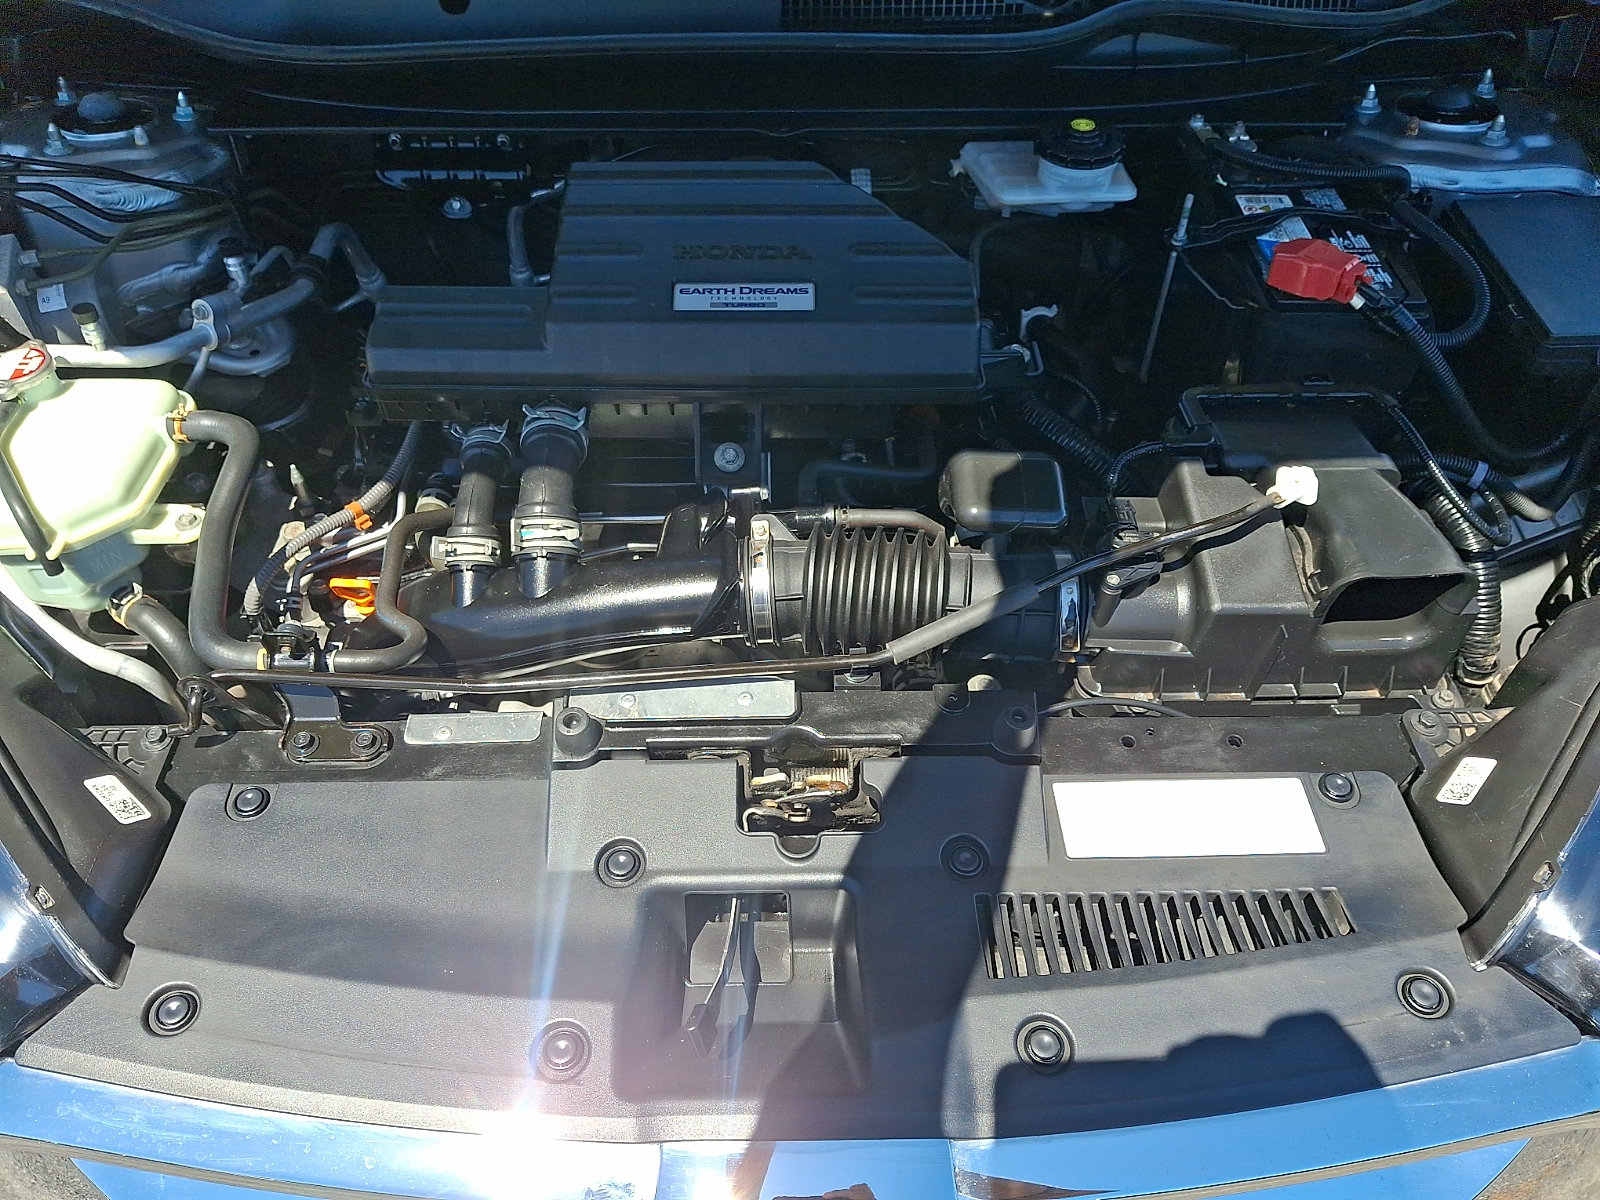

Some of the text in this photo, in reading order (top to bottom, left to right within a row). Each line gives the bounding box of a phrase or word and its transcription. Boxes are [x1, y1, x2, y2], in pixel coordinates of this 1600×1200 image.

[672, 245, 812, 260] HONDA
[679, 286, 809, 295] EARTH DREAMS
[89, 549, 124, 573] MIN
